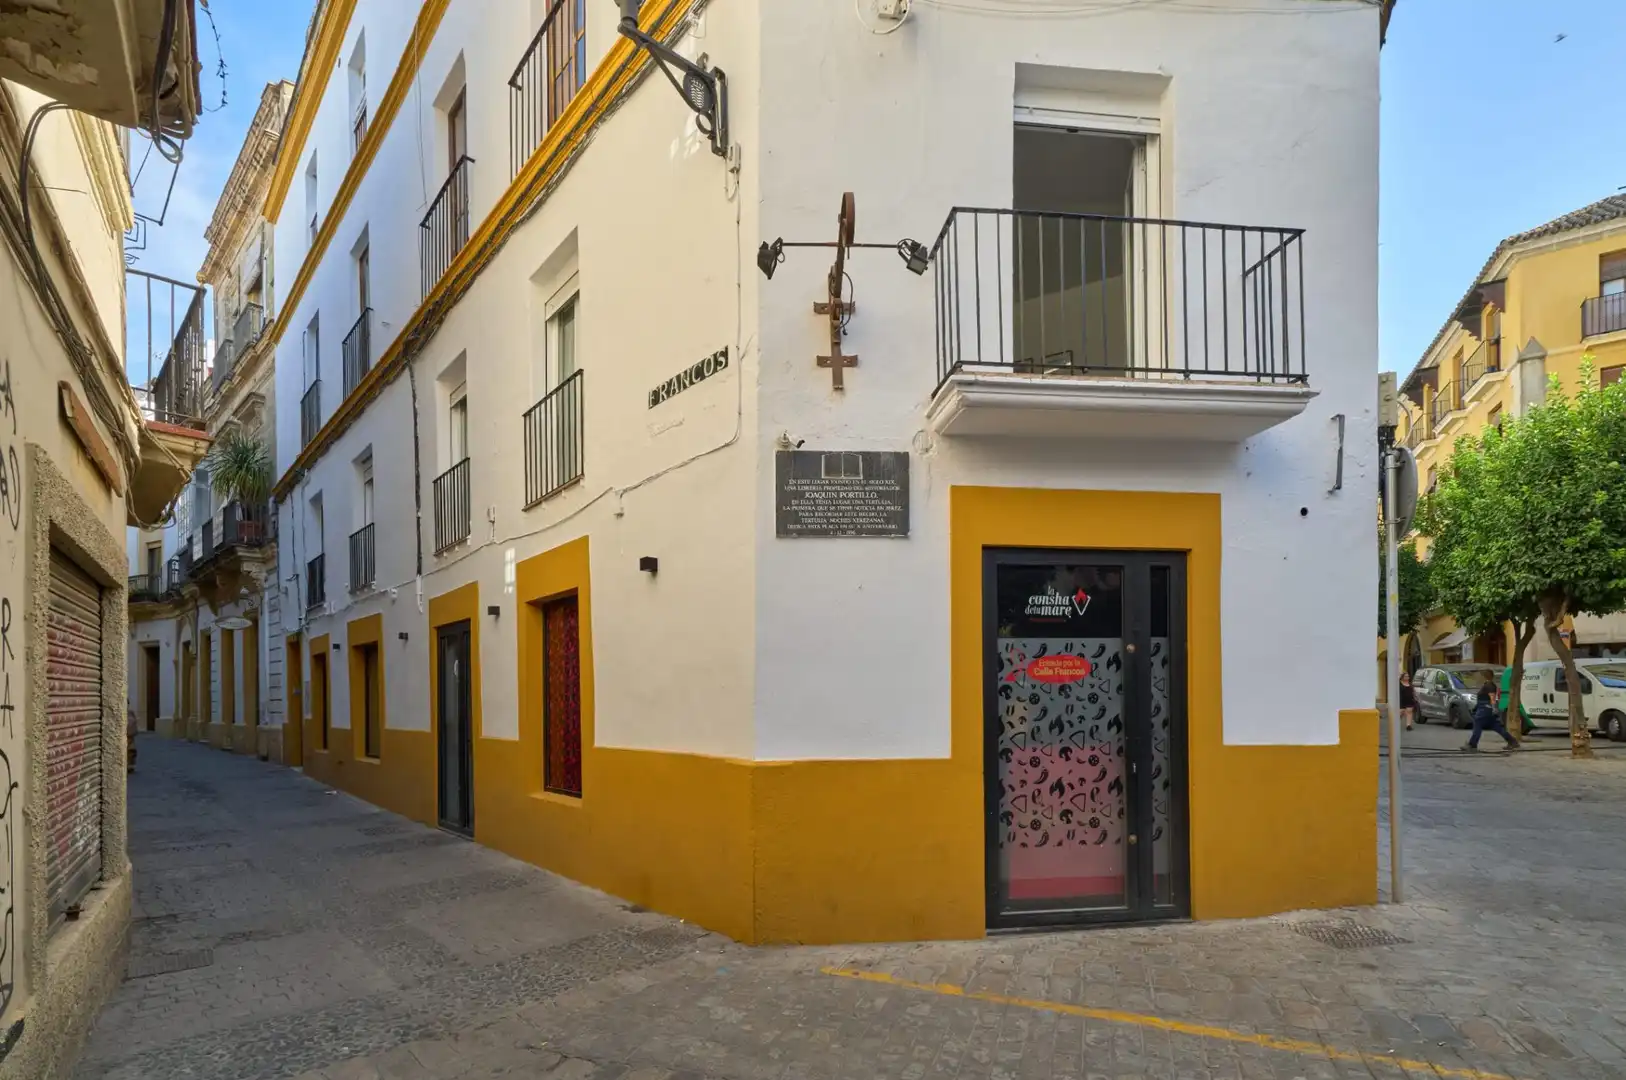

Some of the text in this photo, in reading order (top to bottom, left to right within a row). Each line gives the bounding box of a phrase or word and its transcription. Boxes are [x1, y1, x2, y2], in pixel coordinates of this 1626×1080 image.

[648, 350, 727, 407] FRANCOS
[1047, 585, 1055, 596] la
[1028, 591, 1070, 606] consha
[1033, 667, 1086, 677] Calle Francos
